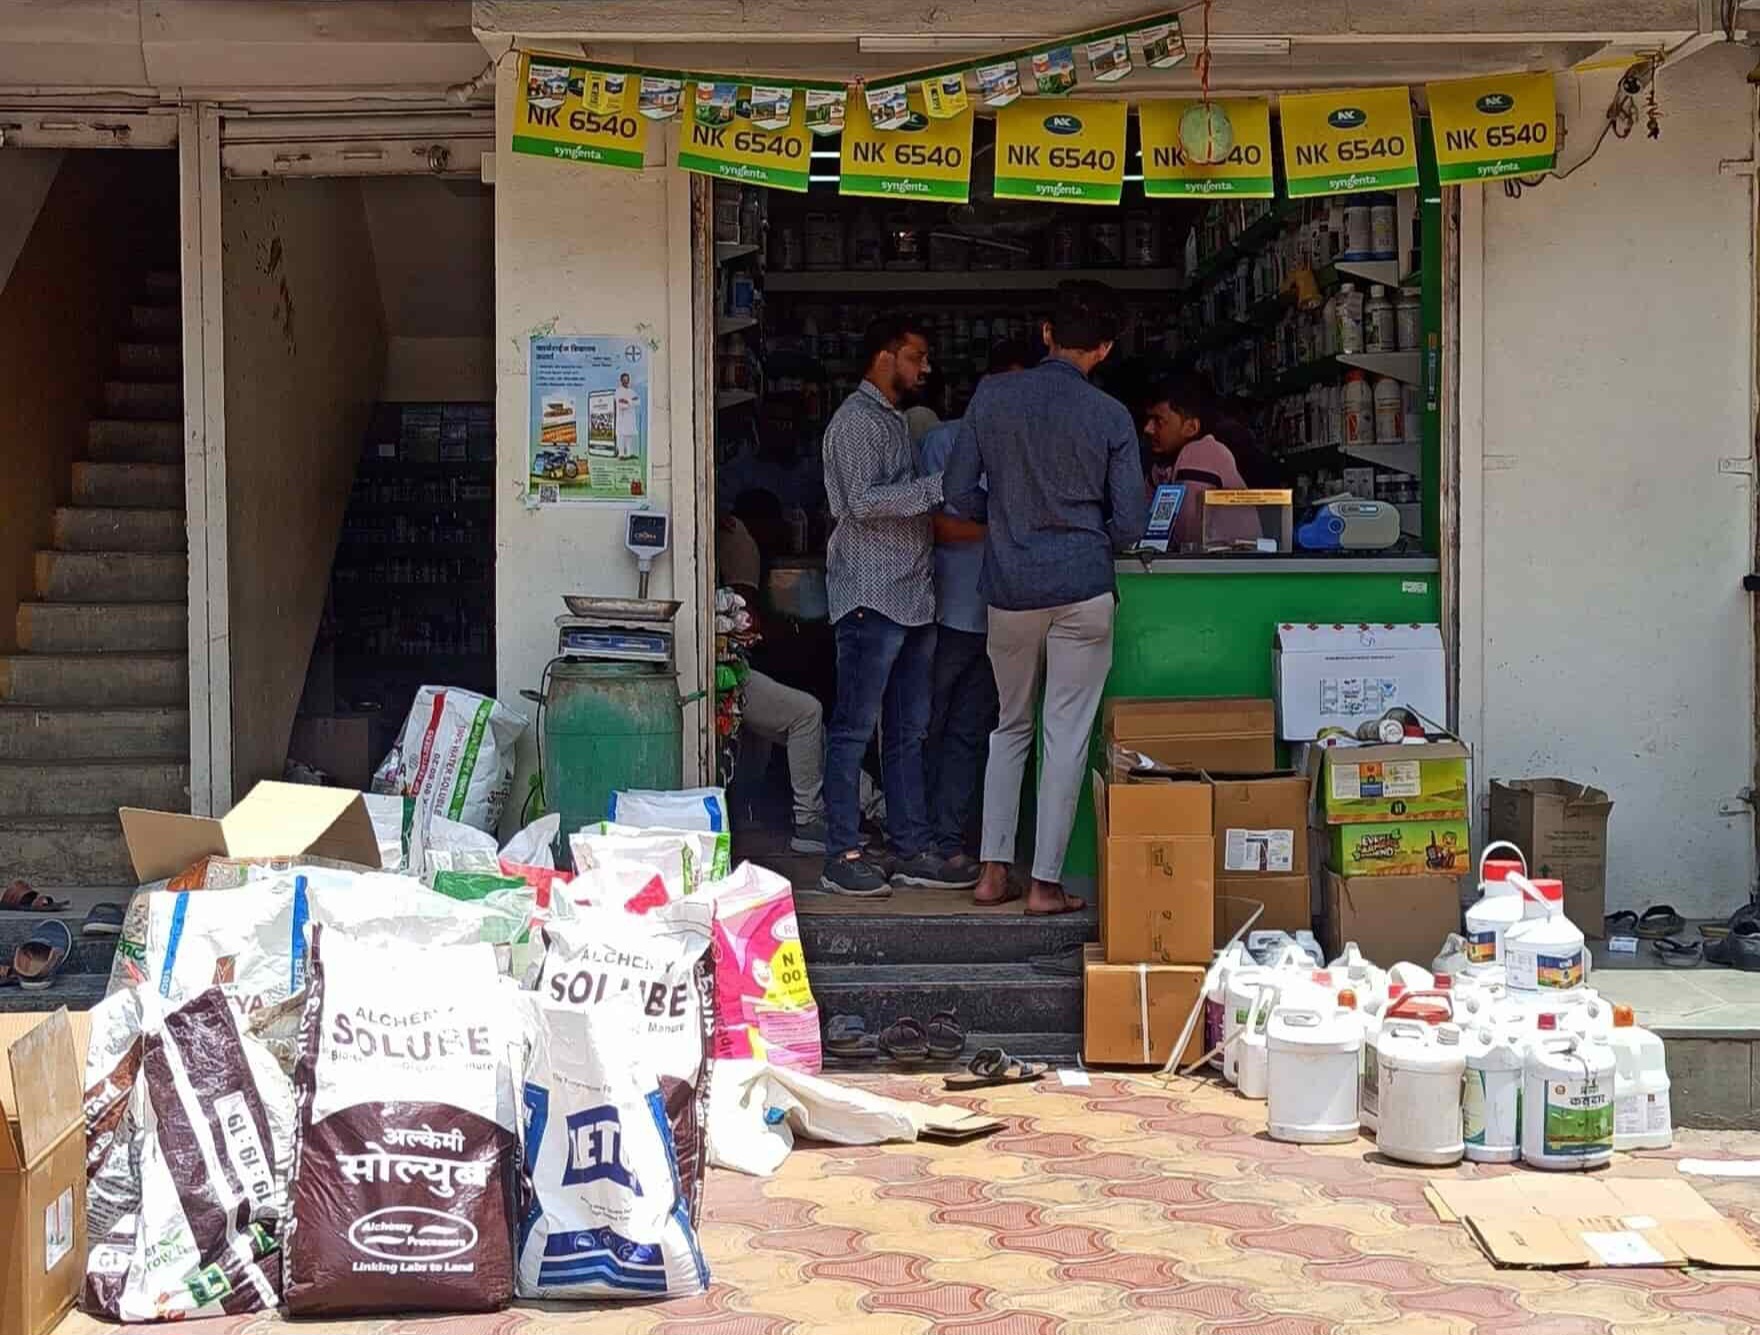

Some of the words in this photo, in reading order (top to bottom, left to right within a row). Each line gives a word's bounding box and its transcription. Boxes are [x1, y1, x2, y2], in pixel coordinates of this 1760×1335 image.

[527, 106, 560, 128] NK
[568, 110, 638, 138] 6540
[693, 125, 725, 149] NK
[734, 131, 802, 158] 6540
[1446, 128, 1478, 151] NK
[1485, 121, 1547, 148] 6540
[554, 144, 602, 161] syngenta
[853, 142, 886, 163] NK
[895, 143, 962, 168] 6540
[1007, 145, 1041, 166] NK
[1049, 147, 1116, 170] 6540
[1153, 147, 1185, 168] NK
[1296, 143, 1329, 165] NK
[1337, 136, 1405, 161] 6540
[719, 163, 768, 180] syngenta
[1477, 161, 1519, 177] syngenta
[881, 178, 929, 193] syngenta
[1035, 181, 1082, 197] syngenta
[1185, 179, 1232, 194] syngenta
[1329, 173, 1376, 190] syngenta
[433, 774, 450, 817] SOLUBLE
[581, 948, 676, 974] ALCHEY
[356, 1005, 455, 1028] ALCHE
[383, 1123, 467, 1153] अल्केमी
[352, 1262, 398, 1275] Linking
[400, 1262, 428, 1272] Labs
[430, 1262, 443, 1272] to
[444, 1262, 475, 1273] Land
